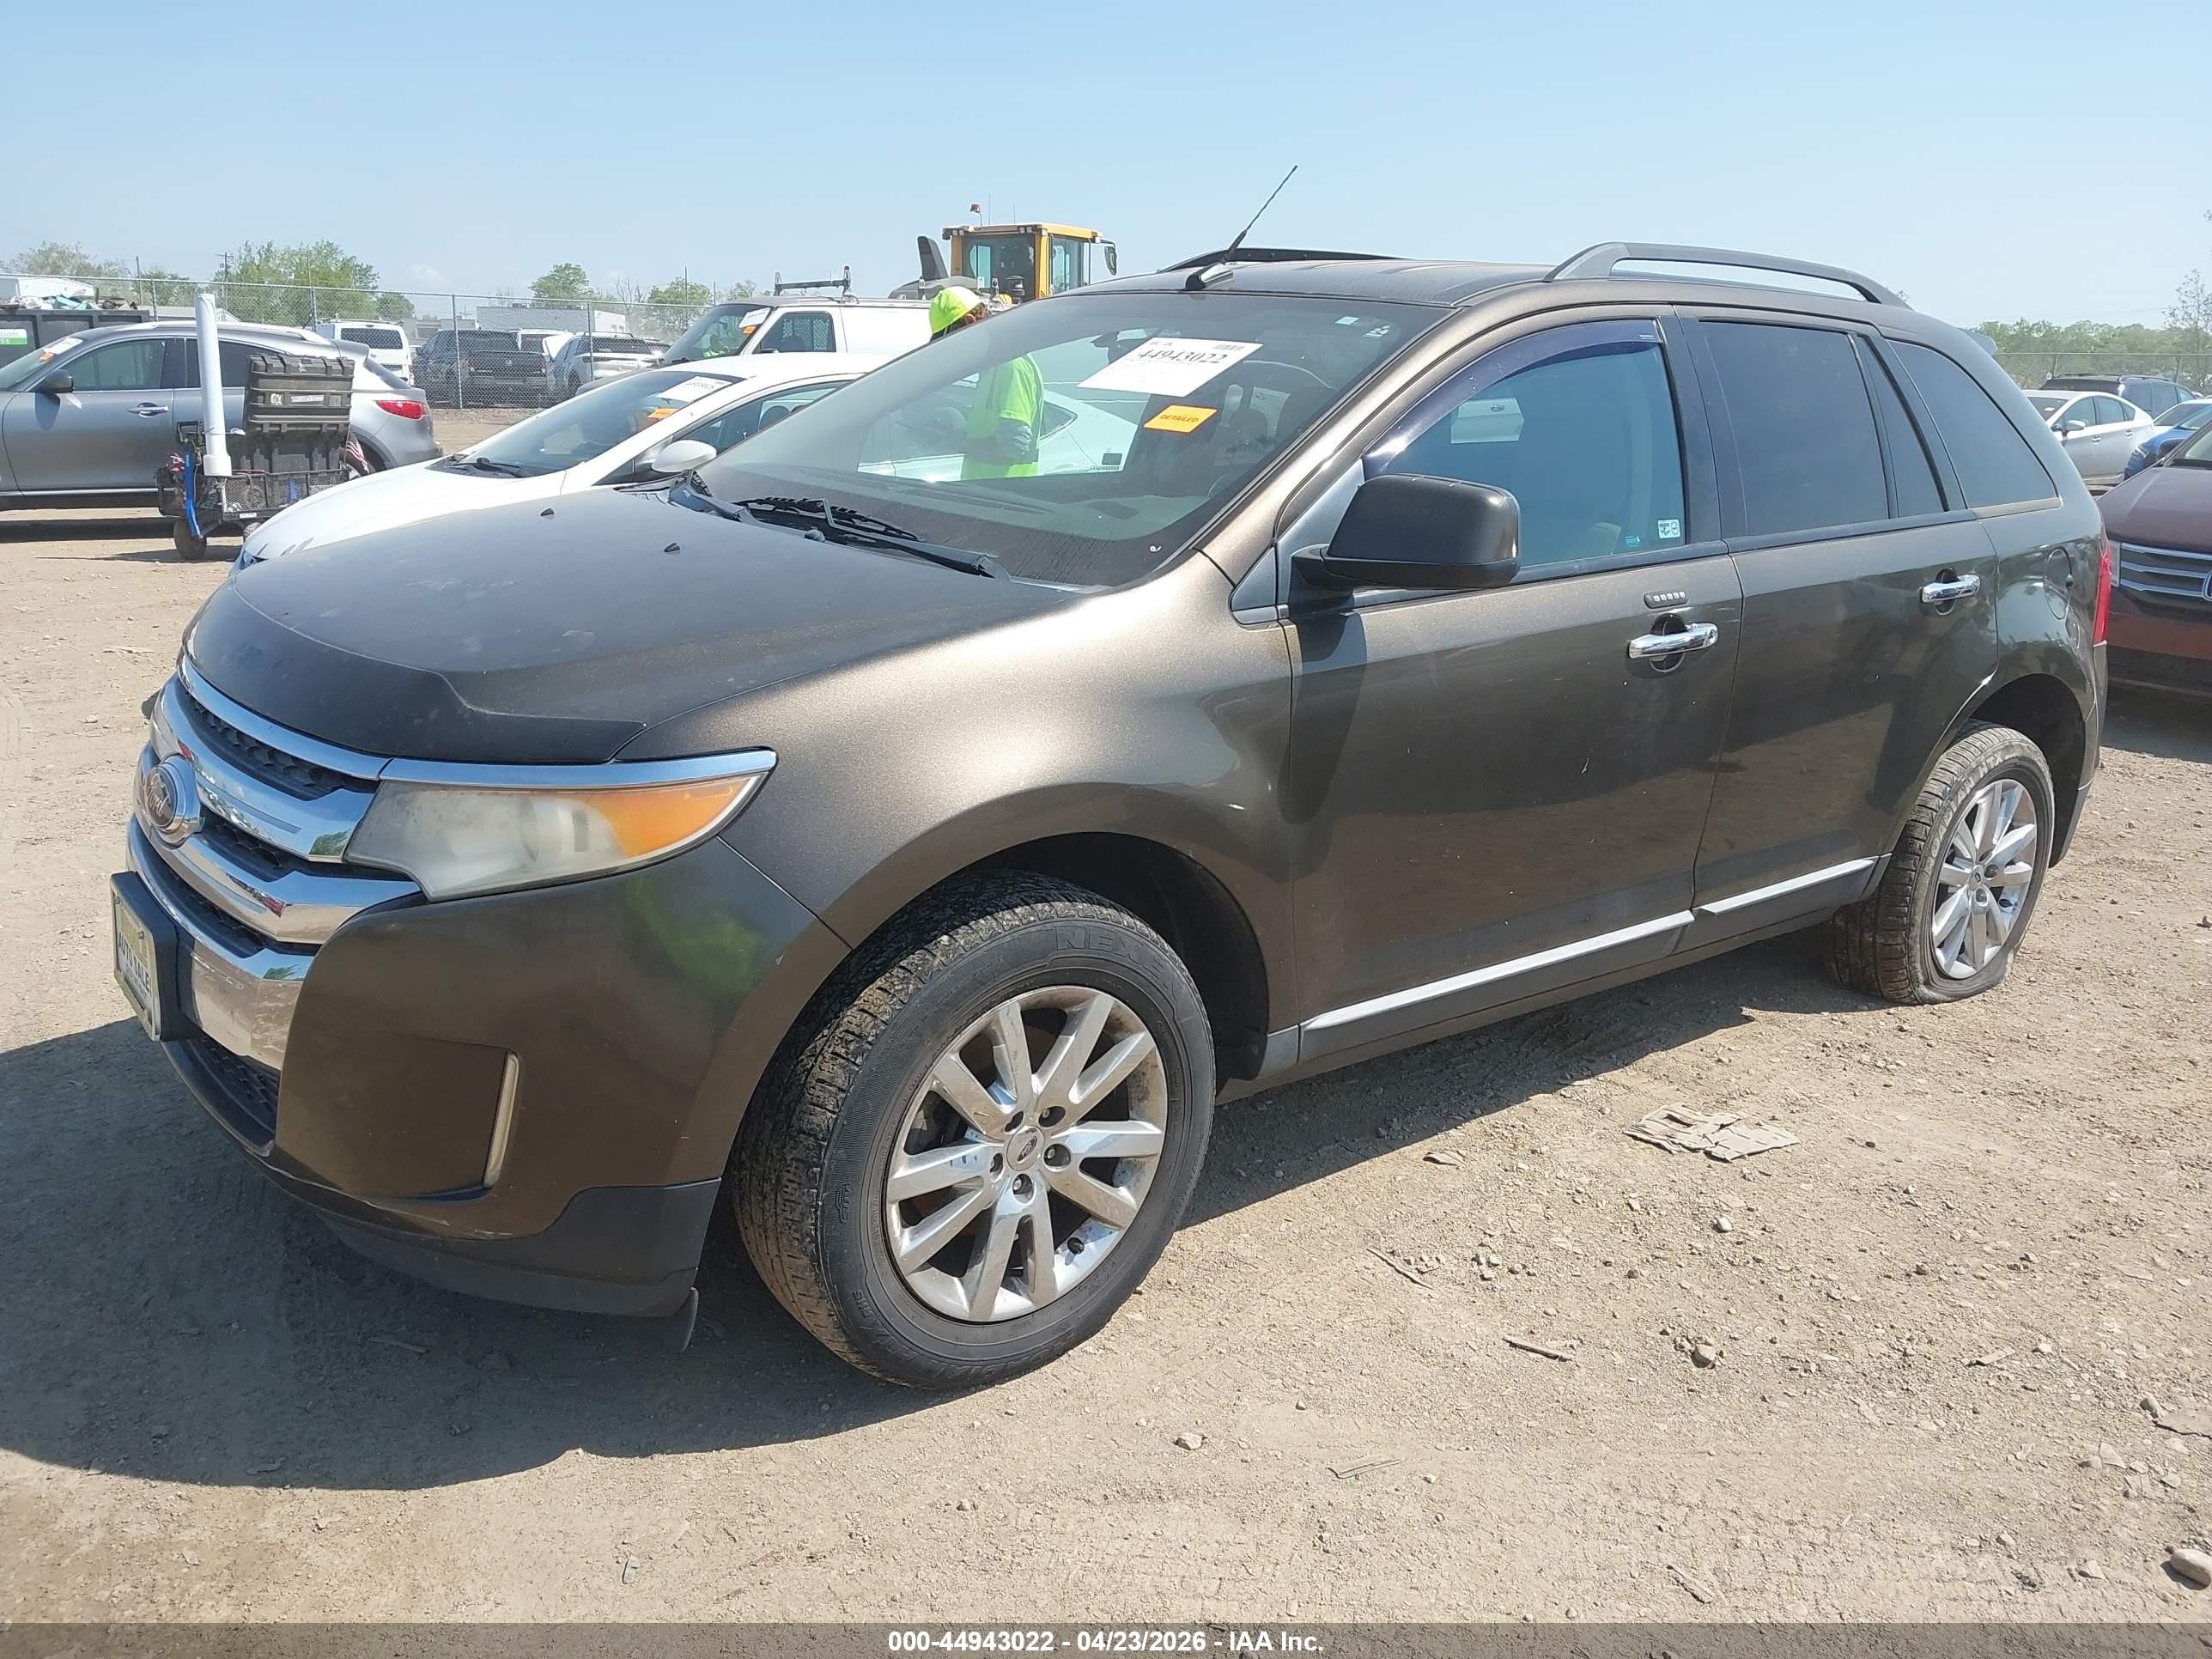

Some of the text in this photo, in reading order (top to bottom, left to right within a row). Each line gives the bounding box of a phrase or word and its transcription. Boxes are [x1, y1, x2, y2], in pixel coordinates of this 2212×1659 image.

[1138, 349, 1228, 364] 44943022
[1159, 414, 1200, 423] DETAILED
[147, 772, 172, 819] Ford
[117, 931, 133, 967] AUTO
[1055, 925, 1186, 1003] NEXEN
